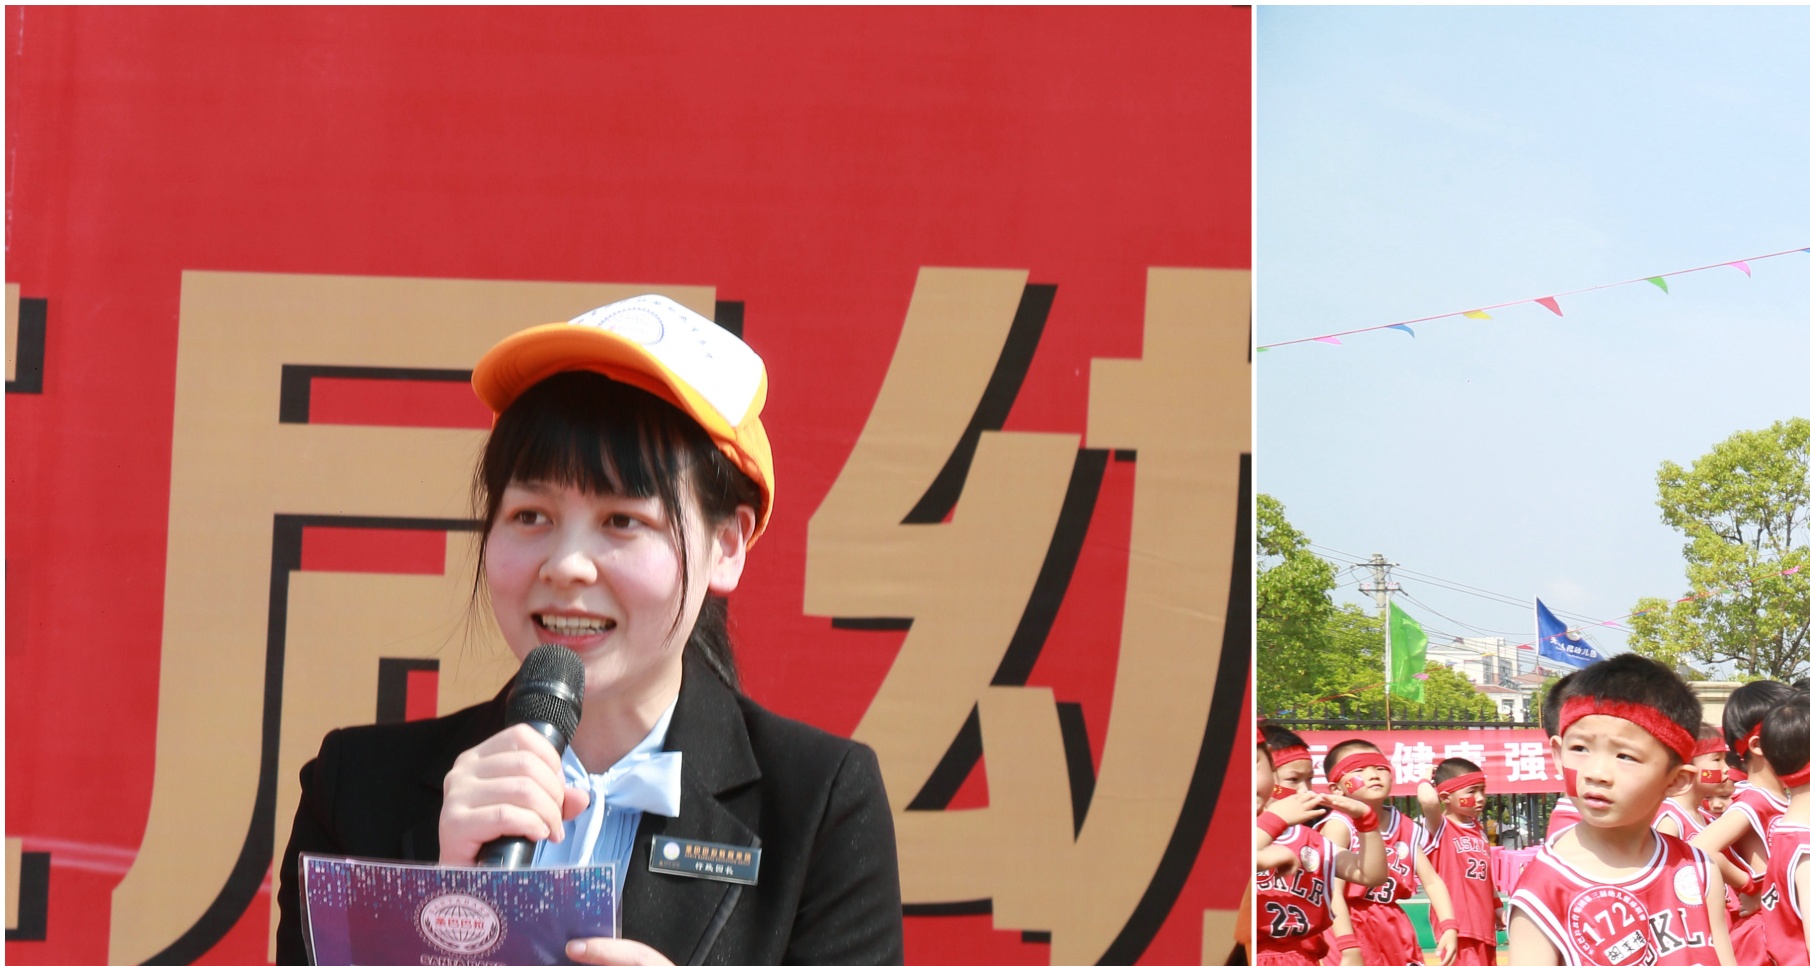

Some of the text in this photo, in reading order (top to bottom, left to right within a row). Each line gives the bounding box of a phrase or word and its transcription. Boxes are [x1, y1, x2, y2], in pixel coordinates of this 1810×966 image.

[1465, 857, 1488, 882] 23
[1266, 902, 1310, 938] 23
[1582, 901, 1636, 947] 172
